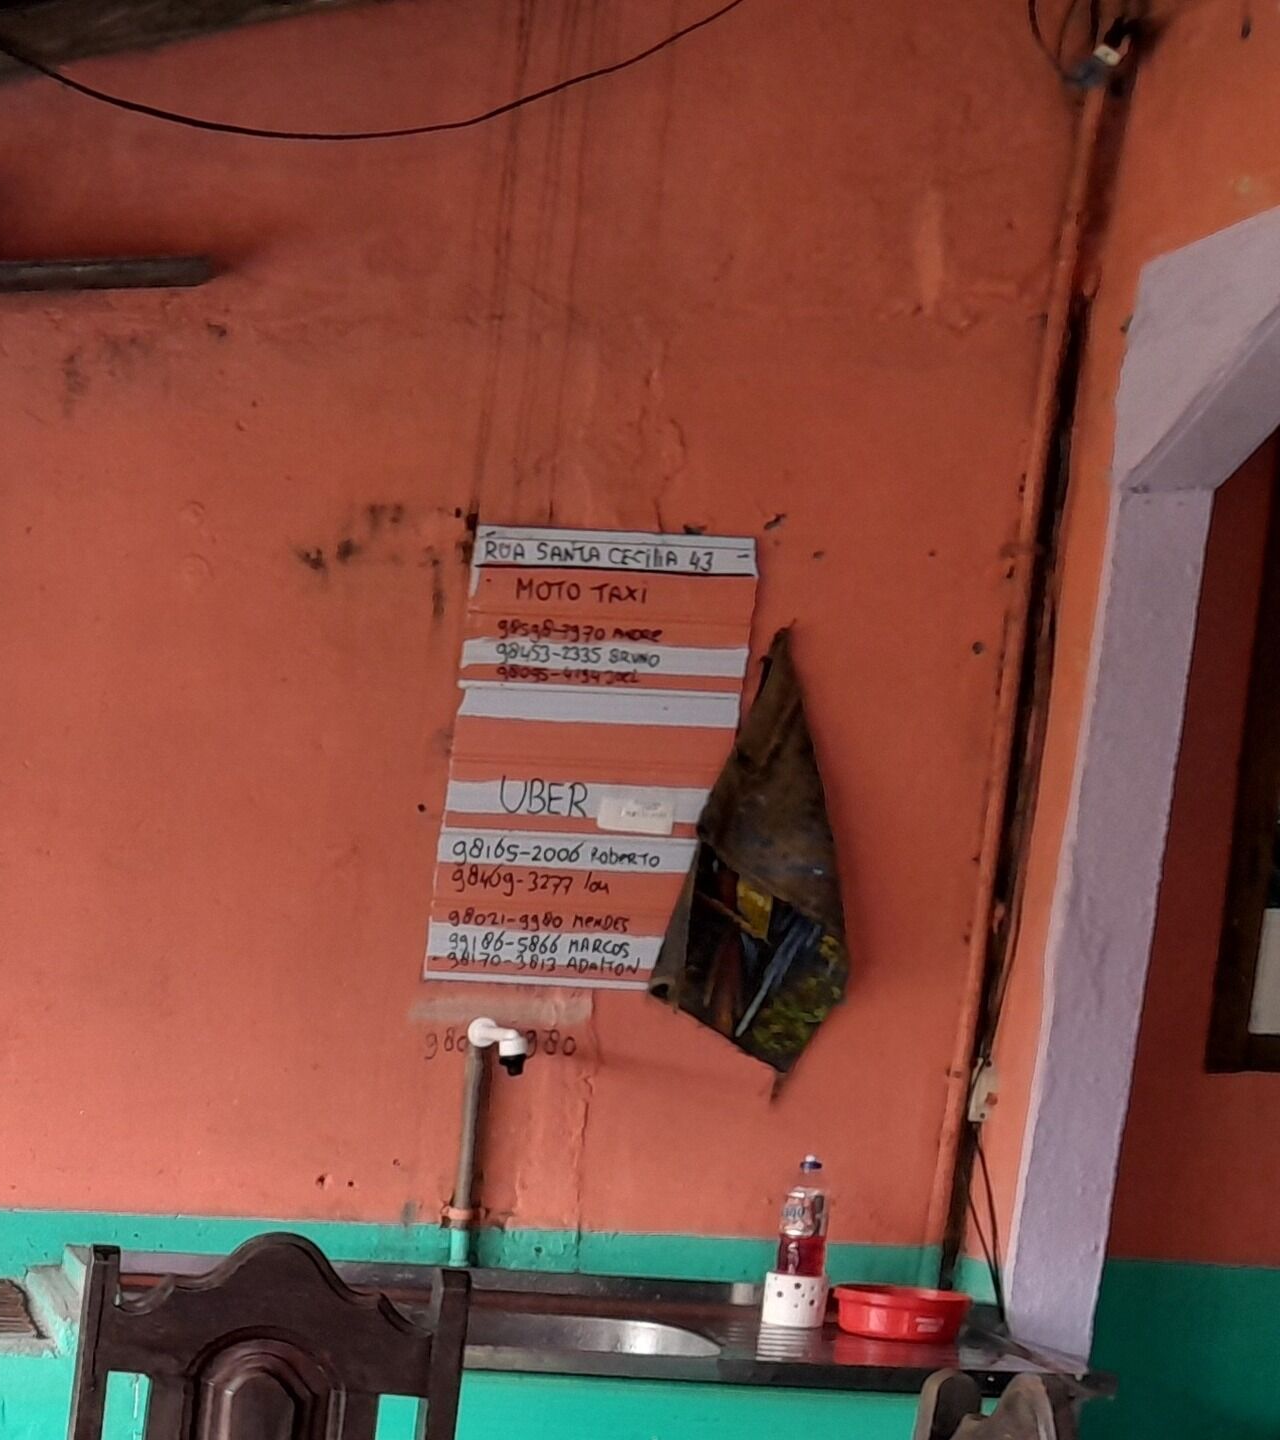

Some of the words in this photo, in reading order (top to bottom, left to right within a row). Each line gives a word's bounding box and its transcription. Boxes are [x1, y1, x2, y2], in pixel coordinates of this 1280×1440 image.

[484, 540, 526, 561] RUA
[537, 542, 600, 563] SANTA
[689, 550, 715, 573] 43
[515, 577, 581, 602] MOTO
[496, 642, 602, 665] 98453-2335
[499, 775, 589, 818] UBER
[452, 837, 585, 865] 98165-2006
[451, 863, 573, 897] 98469-3277
[448, 907, 563, 932] 98021-9980
[449, 930, 561, 955] 99186-5866
[568, 937, 630, 959] MARCOS
